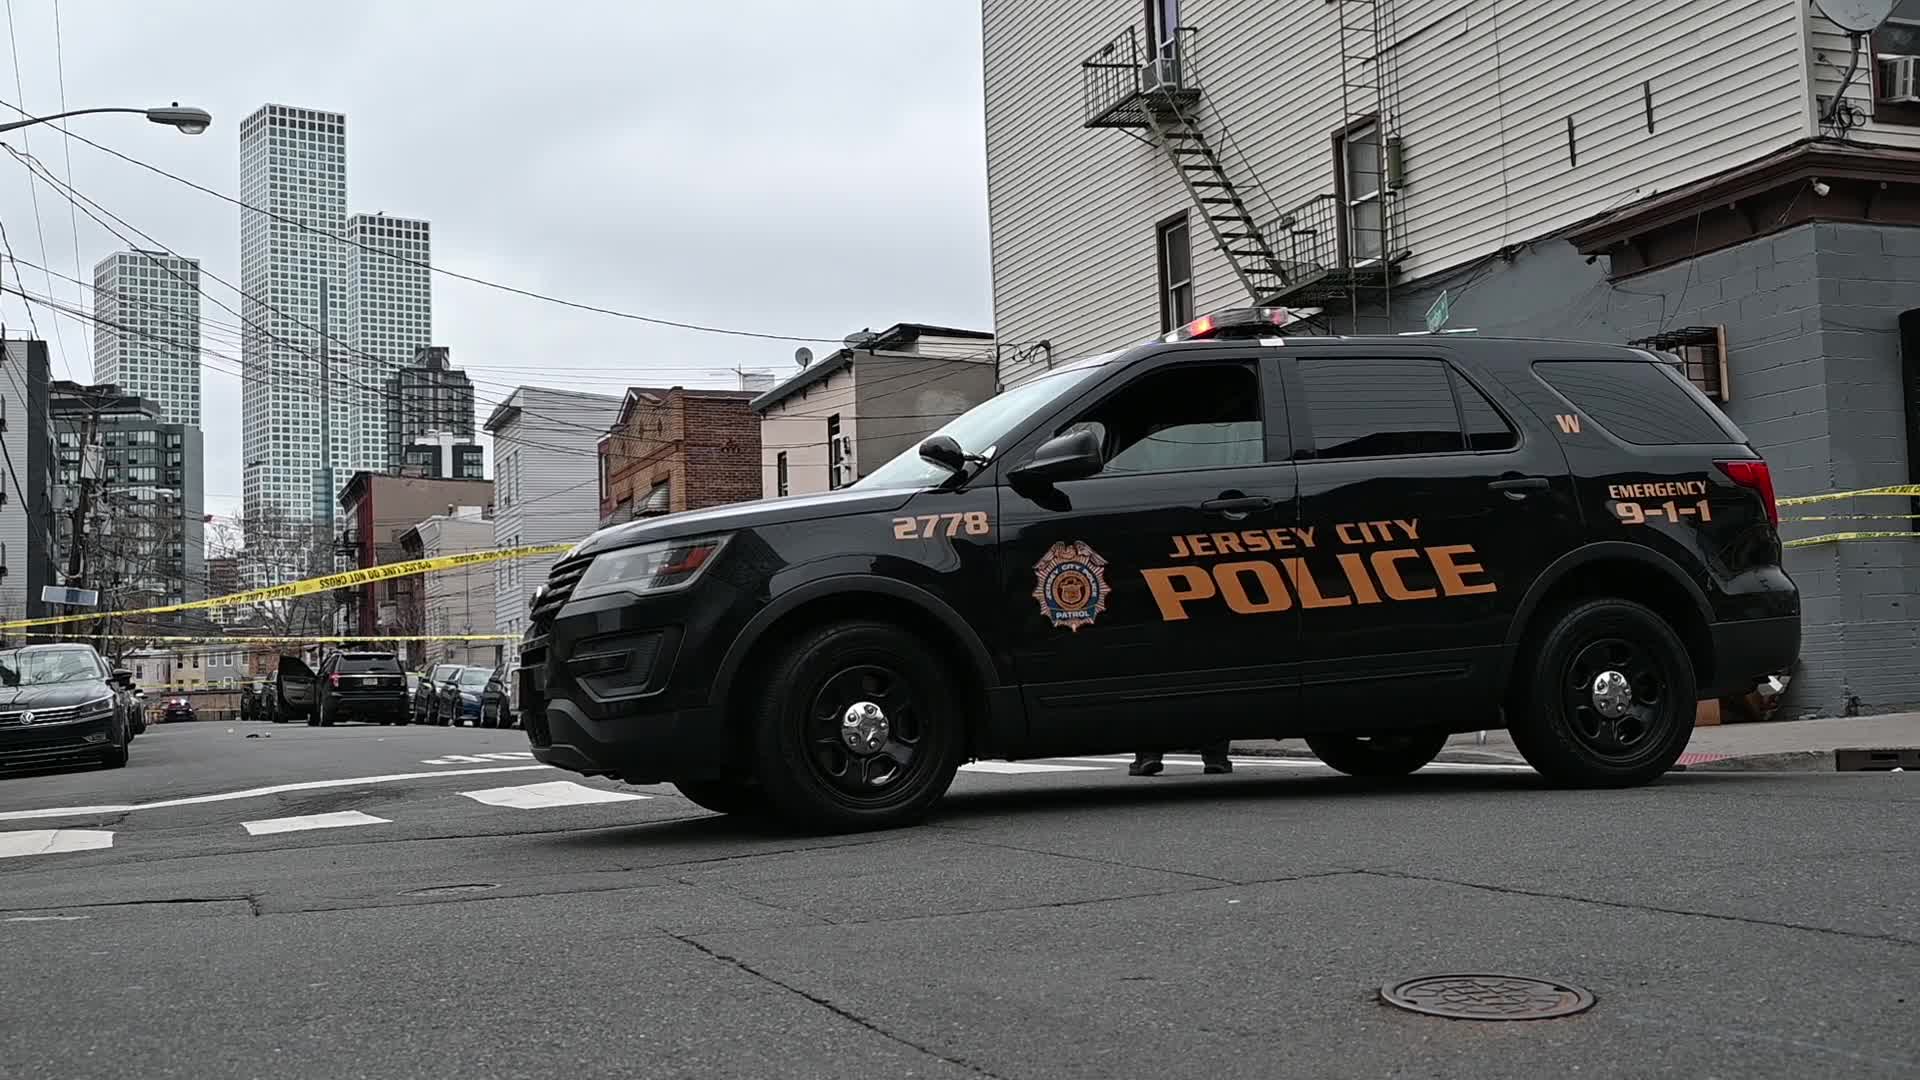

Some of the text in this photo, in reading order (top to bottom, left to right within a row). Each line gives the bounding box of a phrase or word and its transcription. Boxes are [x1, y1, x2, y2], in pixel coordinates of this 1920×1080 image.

[1554, 414, 1582, 433] W
[1608, 480, 1707, 499] EMERGENCY
[1615, 500, 1713, 525] 9-1-1
[892, 511, 990, 539] 2778
[1169, 518, 1420, 558] JERSEY CITY
[1061, 563, 1081, 571] CITY
[319, 574, 347, 589] CROSS
[349, 571, 366, 584] NOT
[1140, 544, 1498, 621] POLICE
[1056, 610, 1090, 619] PATROL
